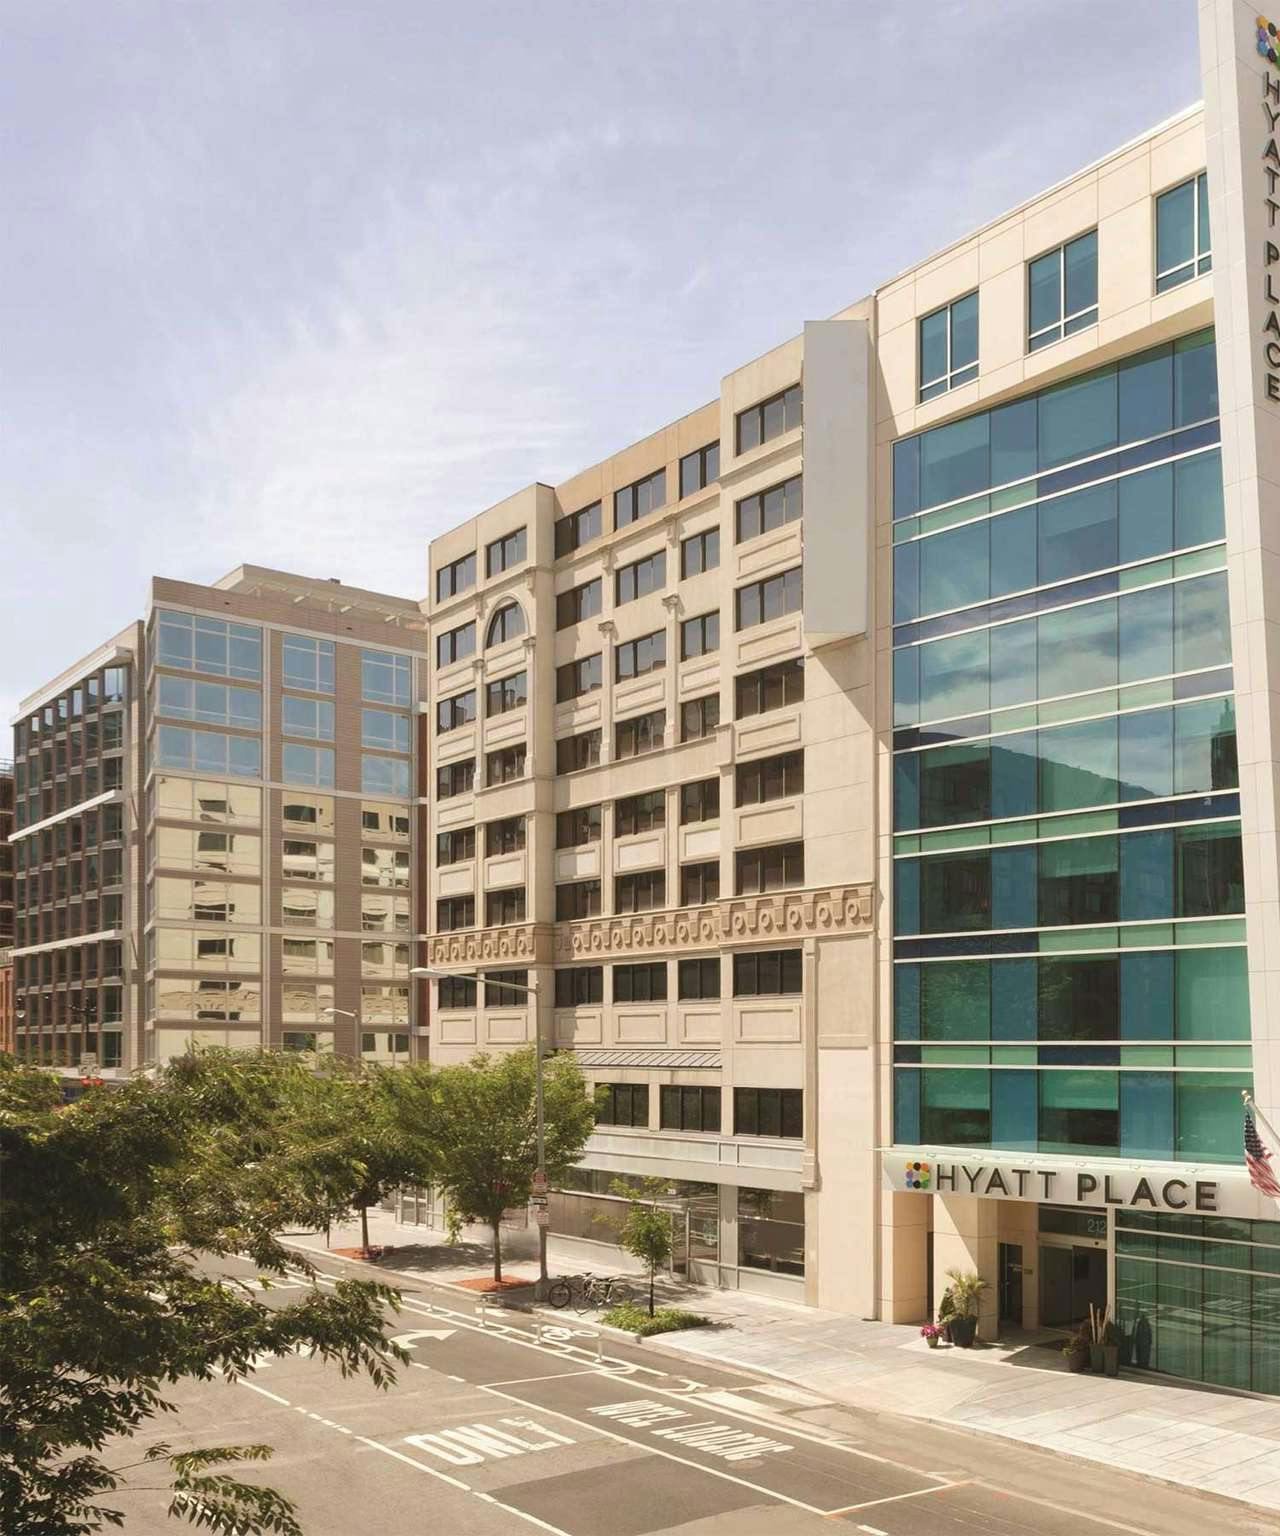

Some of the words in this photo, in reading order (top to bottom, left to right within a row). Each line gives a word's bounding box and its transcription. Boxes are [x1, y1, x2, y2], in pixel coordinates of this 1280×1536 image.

[936, 1163, 1056, 1199] HYATT
[1077, 1173, 1218, 1212] PLACE
[402, 1416, 577, 1466] ONLY
[586, 1399, 693, 1428] HOTEL
[650, 1420, 795, 1461] LOADING
